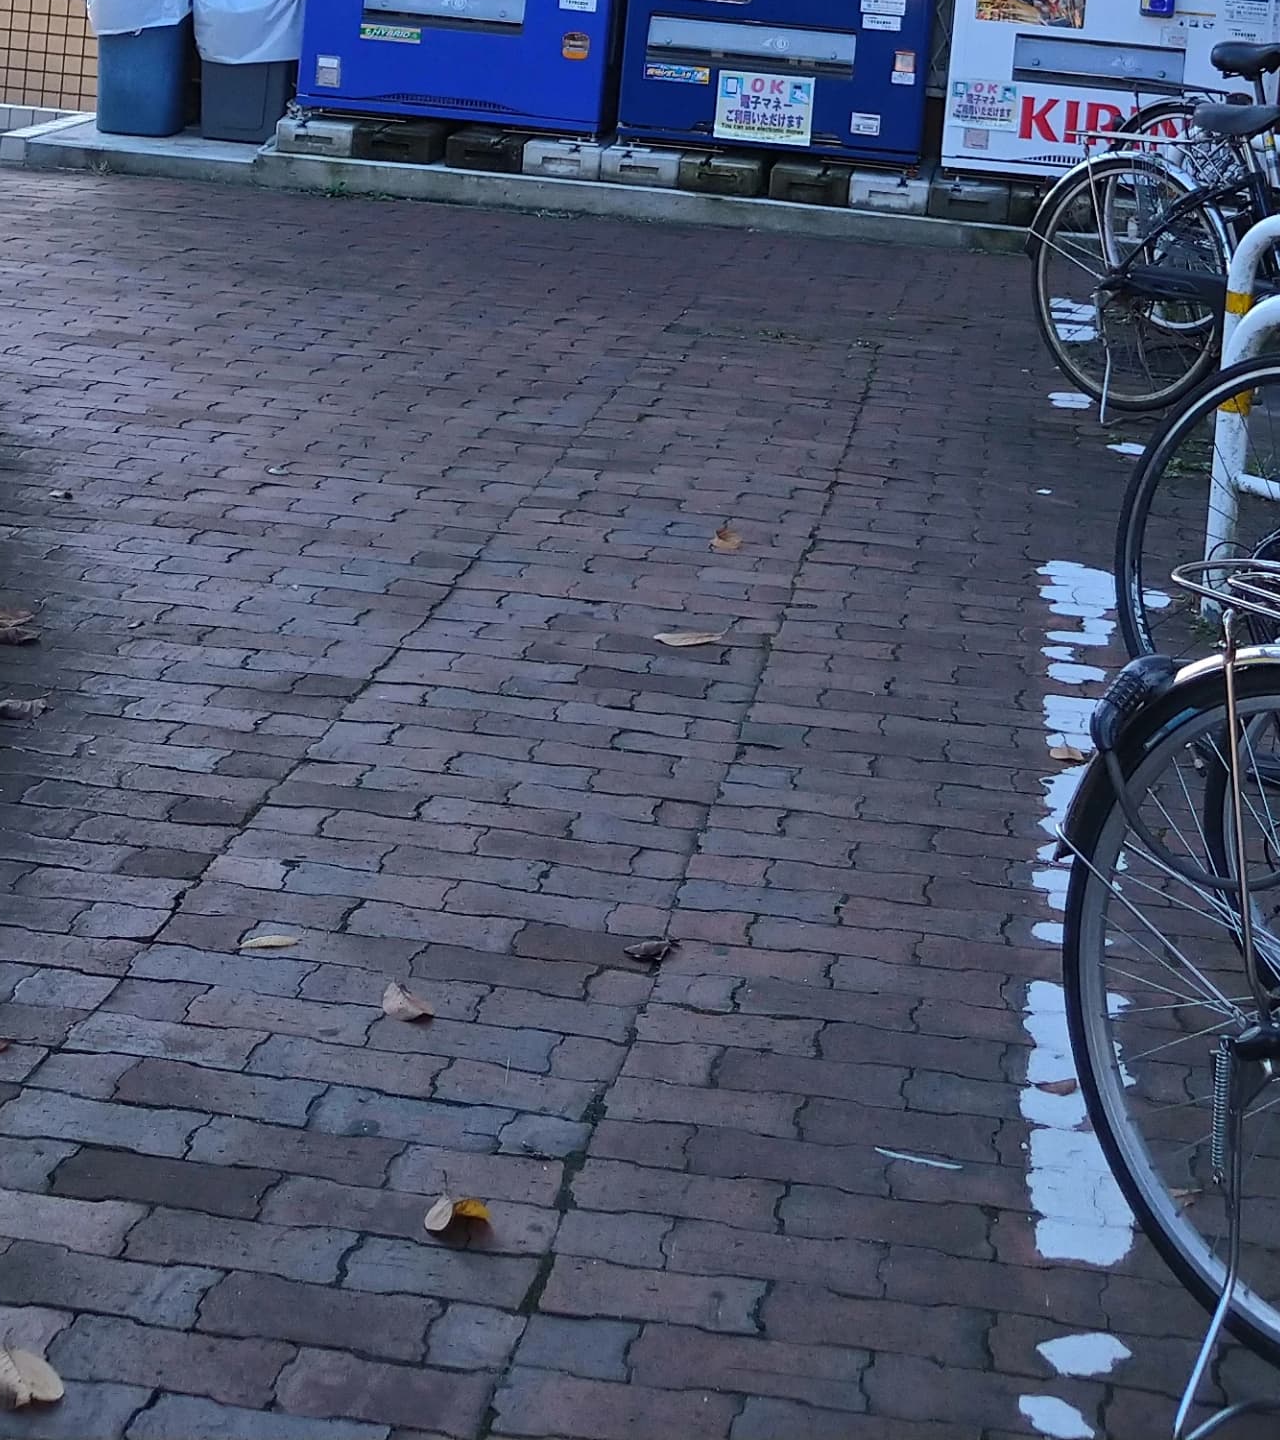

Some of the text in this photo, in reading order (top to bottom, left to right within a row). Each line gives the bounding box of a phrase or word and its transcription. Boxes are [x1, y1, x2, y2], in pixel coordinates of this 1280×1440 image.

[740, 94, 793, 112] 電子マネー
[726, 109, 804, 129] ご利用いただけます
